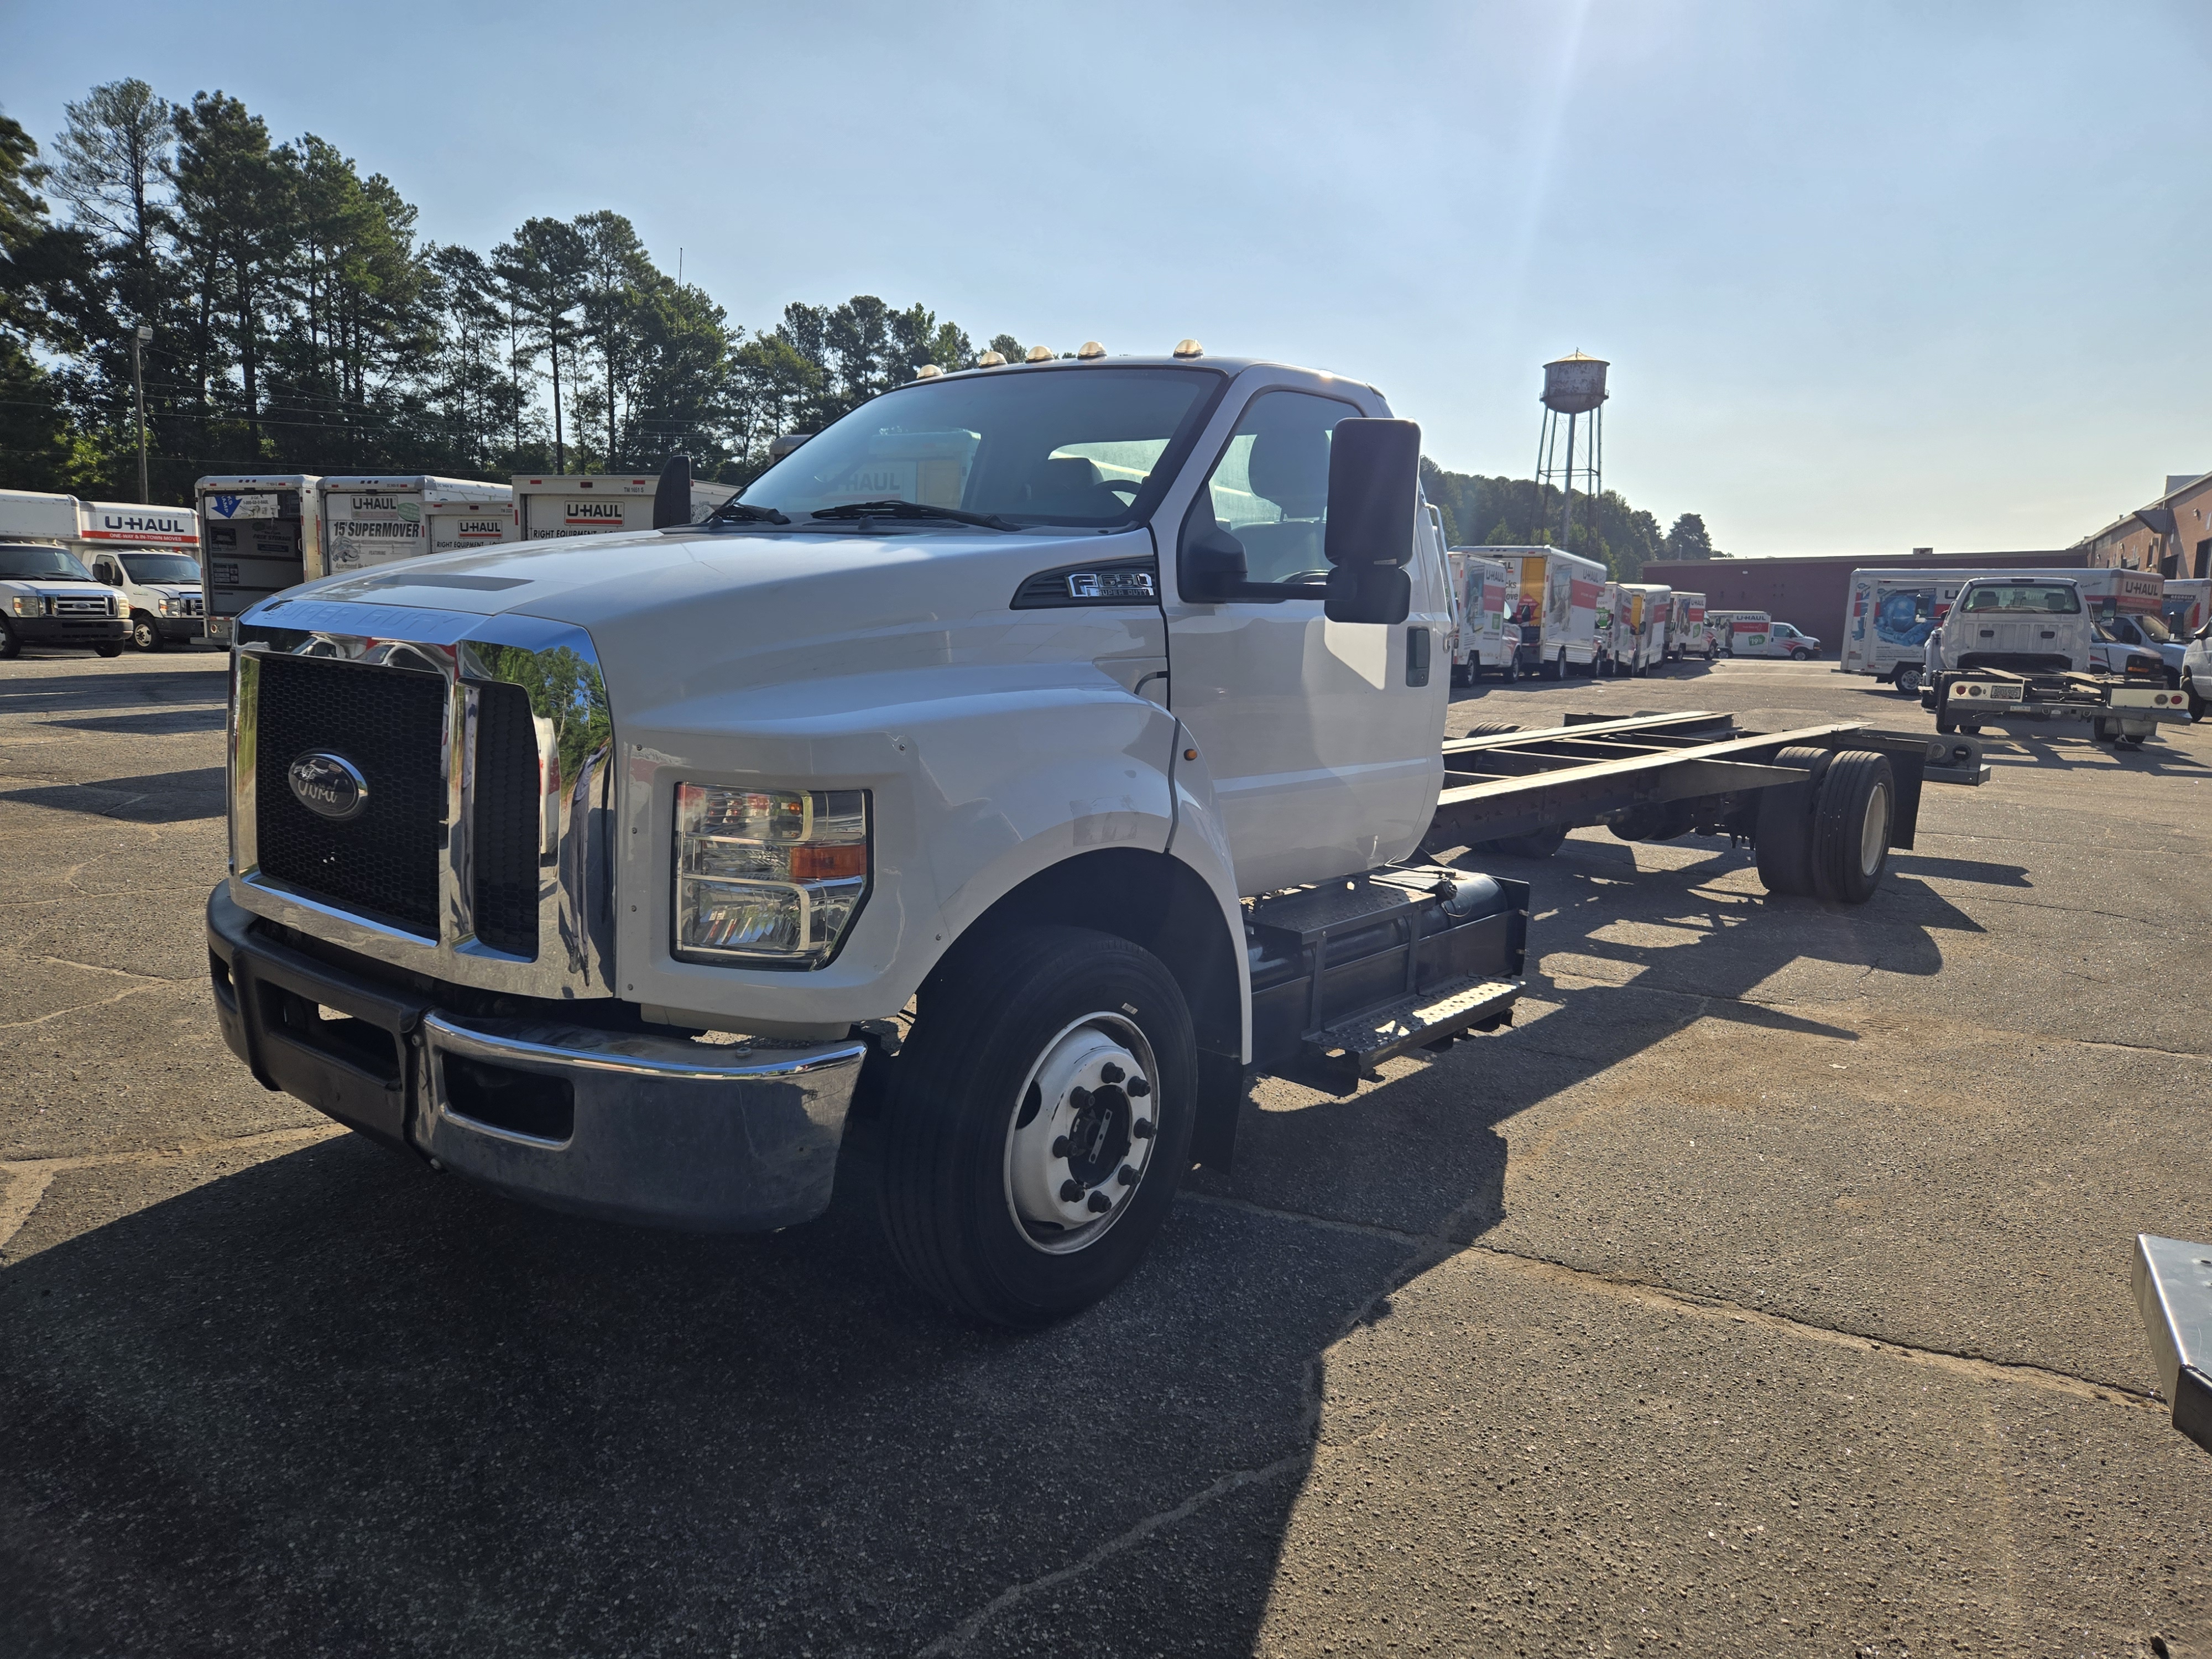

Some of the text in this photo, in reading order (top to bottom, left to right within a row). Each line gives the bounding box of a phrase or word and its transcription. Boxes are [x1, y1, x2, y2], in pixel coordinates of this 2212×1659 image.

[823, 472, 900, 491] -HAUL
[353, 498, 397, 509] U-HAUL
[567, 504, 622, 517] U-HAUL
[105, 516, 184, 533] U-HAUL
[348, 521, 420, 538] SUPERMOVER
[460, 522, 500, 532] U-HAUL
[534, 530, 554, 538] RIGHT
[1486, 570, 1504, 582] U-HAUL
[1583, 568, 1598, 583] U-HAUL
[2125, 581, 2158, 596] U-HAUL
